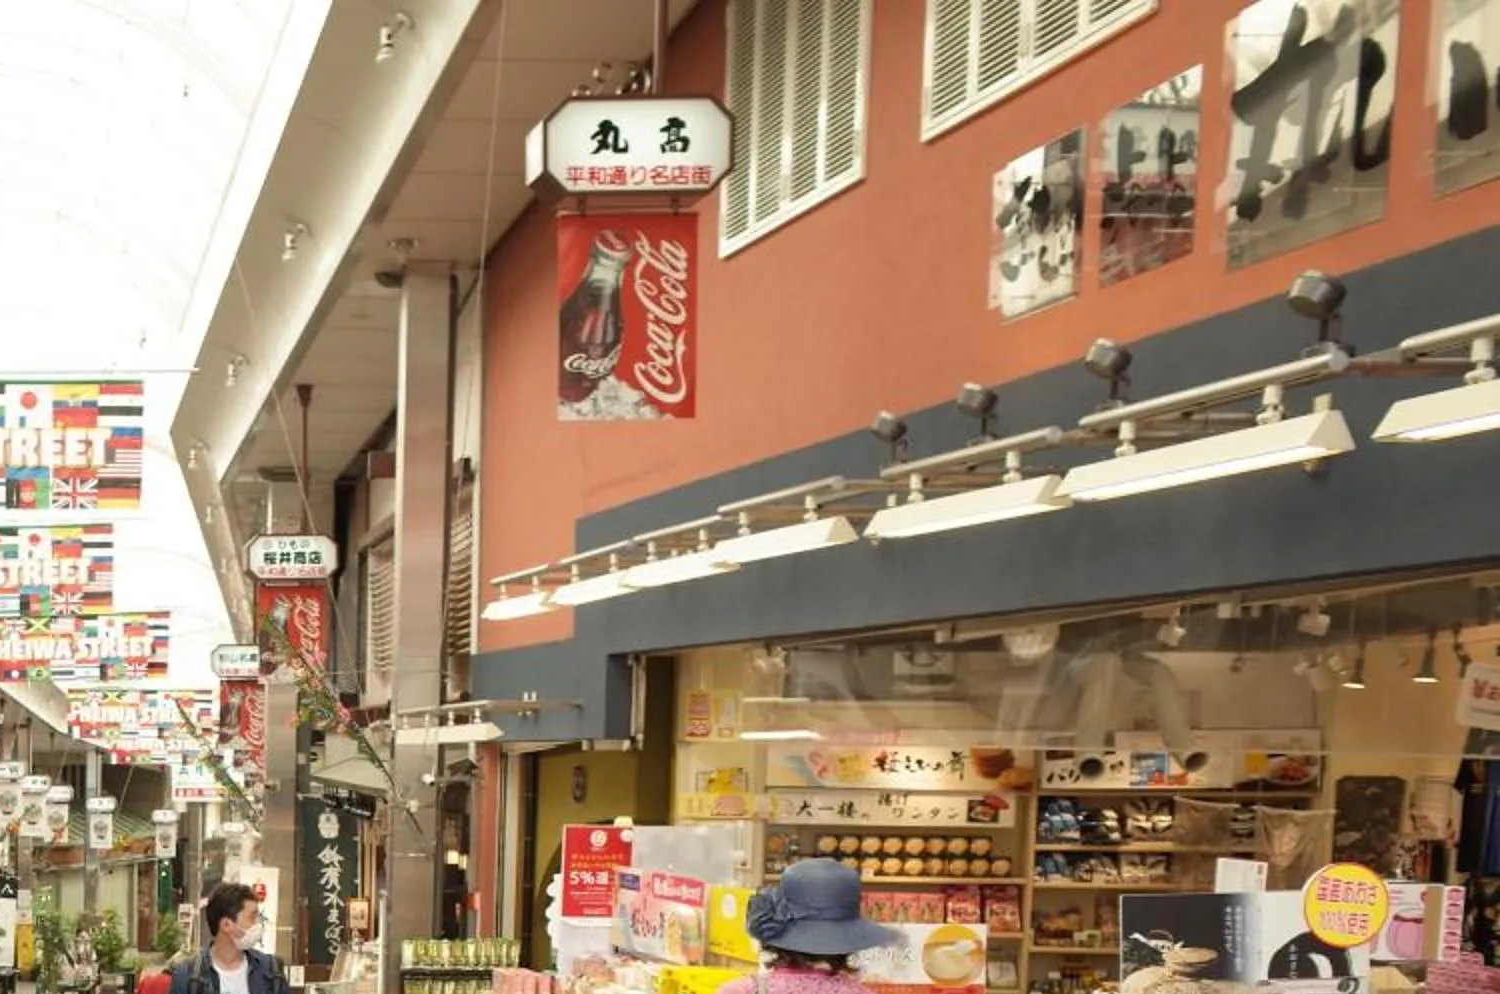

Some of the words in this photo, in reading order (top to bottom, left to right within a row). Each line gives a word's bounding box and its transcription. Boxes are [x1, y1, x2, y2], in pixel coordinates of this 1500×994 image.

[566, 164, 712, 185] 平和通り名店街
[2, 638, 72, 660] HEIWA
[74, 636, 153, 660] STREET
